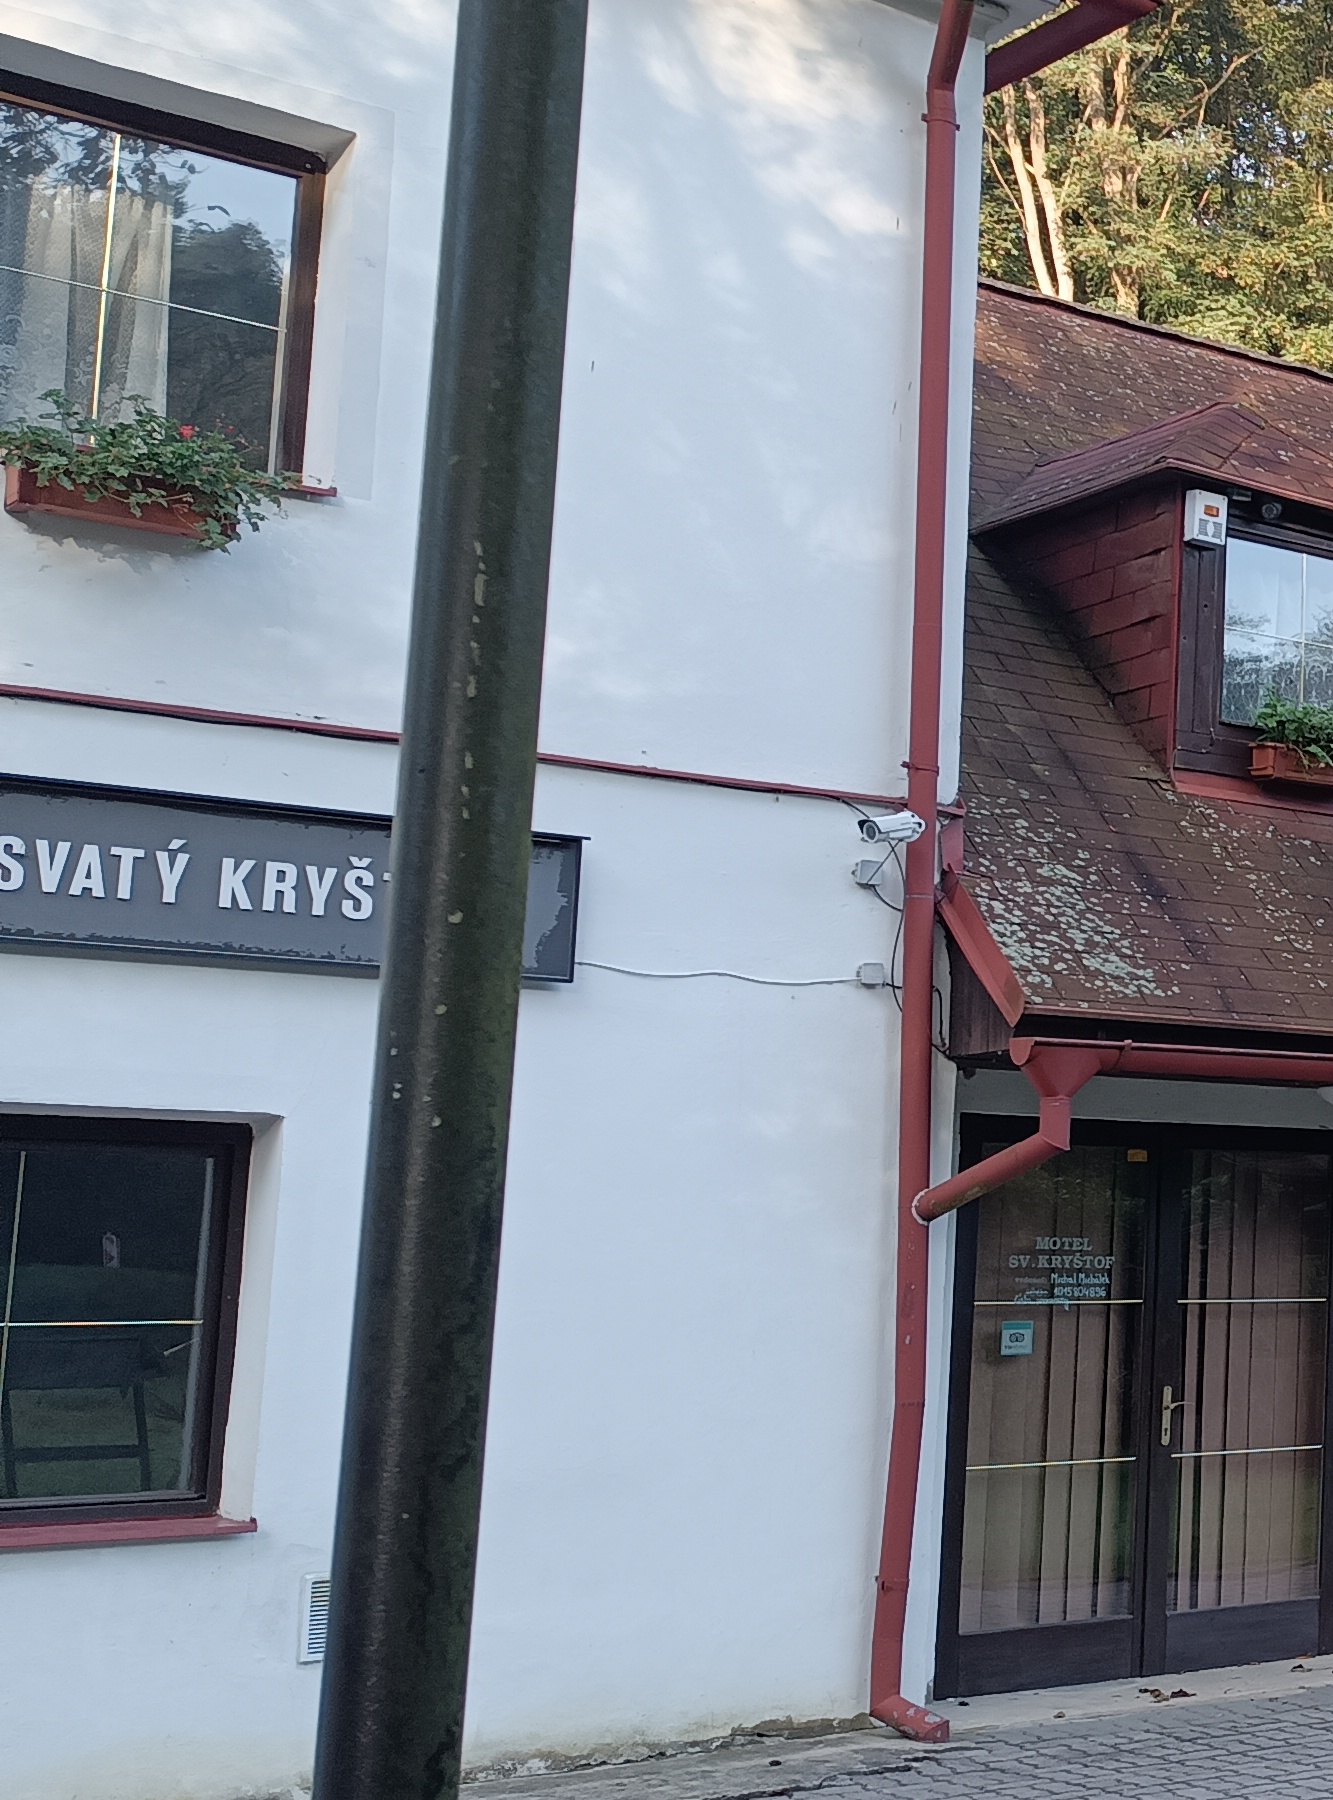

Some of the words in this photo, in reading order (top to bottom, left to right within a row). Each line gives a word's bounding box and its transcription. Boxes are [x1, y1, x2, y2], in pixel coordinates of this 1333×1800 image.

[0, 835, 190, 904] SVATÝ
[218, 856, 391, 920] KRYŠ
[1035, 1236, 1093, 1251] MOTEL
